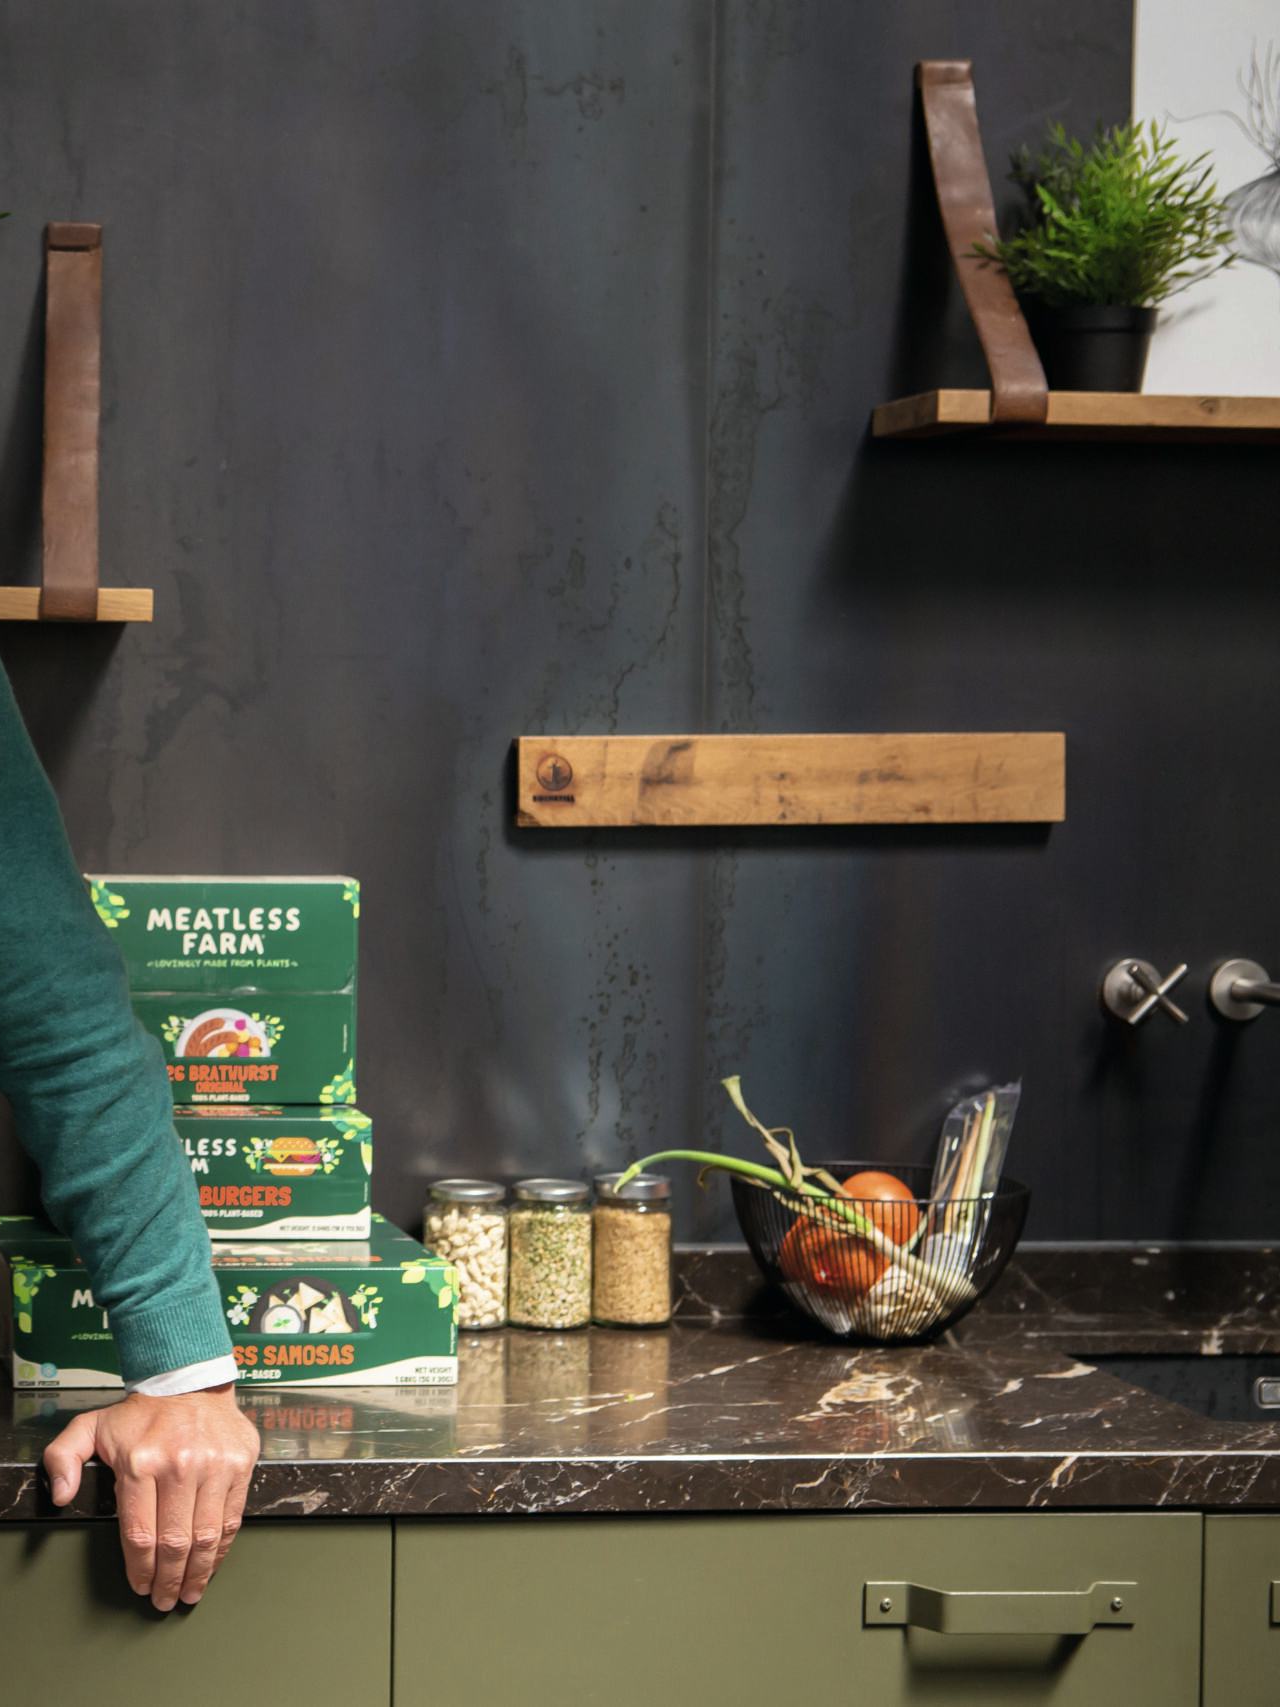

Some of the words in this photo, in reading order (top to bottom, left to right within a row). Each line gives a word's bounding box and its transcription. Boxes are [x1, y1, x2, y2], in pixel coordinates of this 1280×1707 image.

[147, 907, 300, 931] MEATLESS
[183, 932, 264, 955] FARM
[155, 959, 201, 968] LOVINGLY
[203, 959, 227, 968] MADE
[231, 959, 254, 968] FROM
[257, 959, 290, 968] PLANTS
[189, 1064, 279, 1081] BRATWURST
[182, 1138, 237, 1157] LESS
[200, 1185, 292, 1206] BURGERS
[263, 1344, 355, 1366] SAMOSAS
